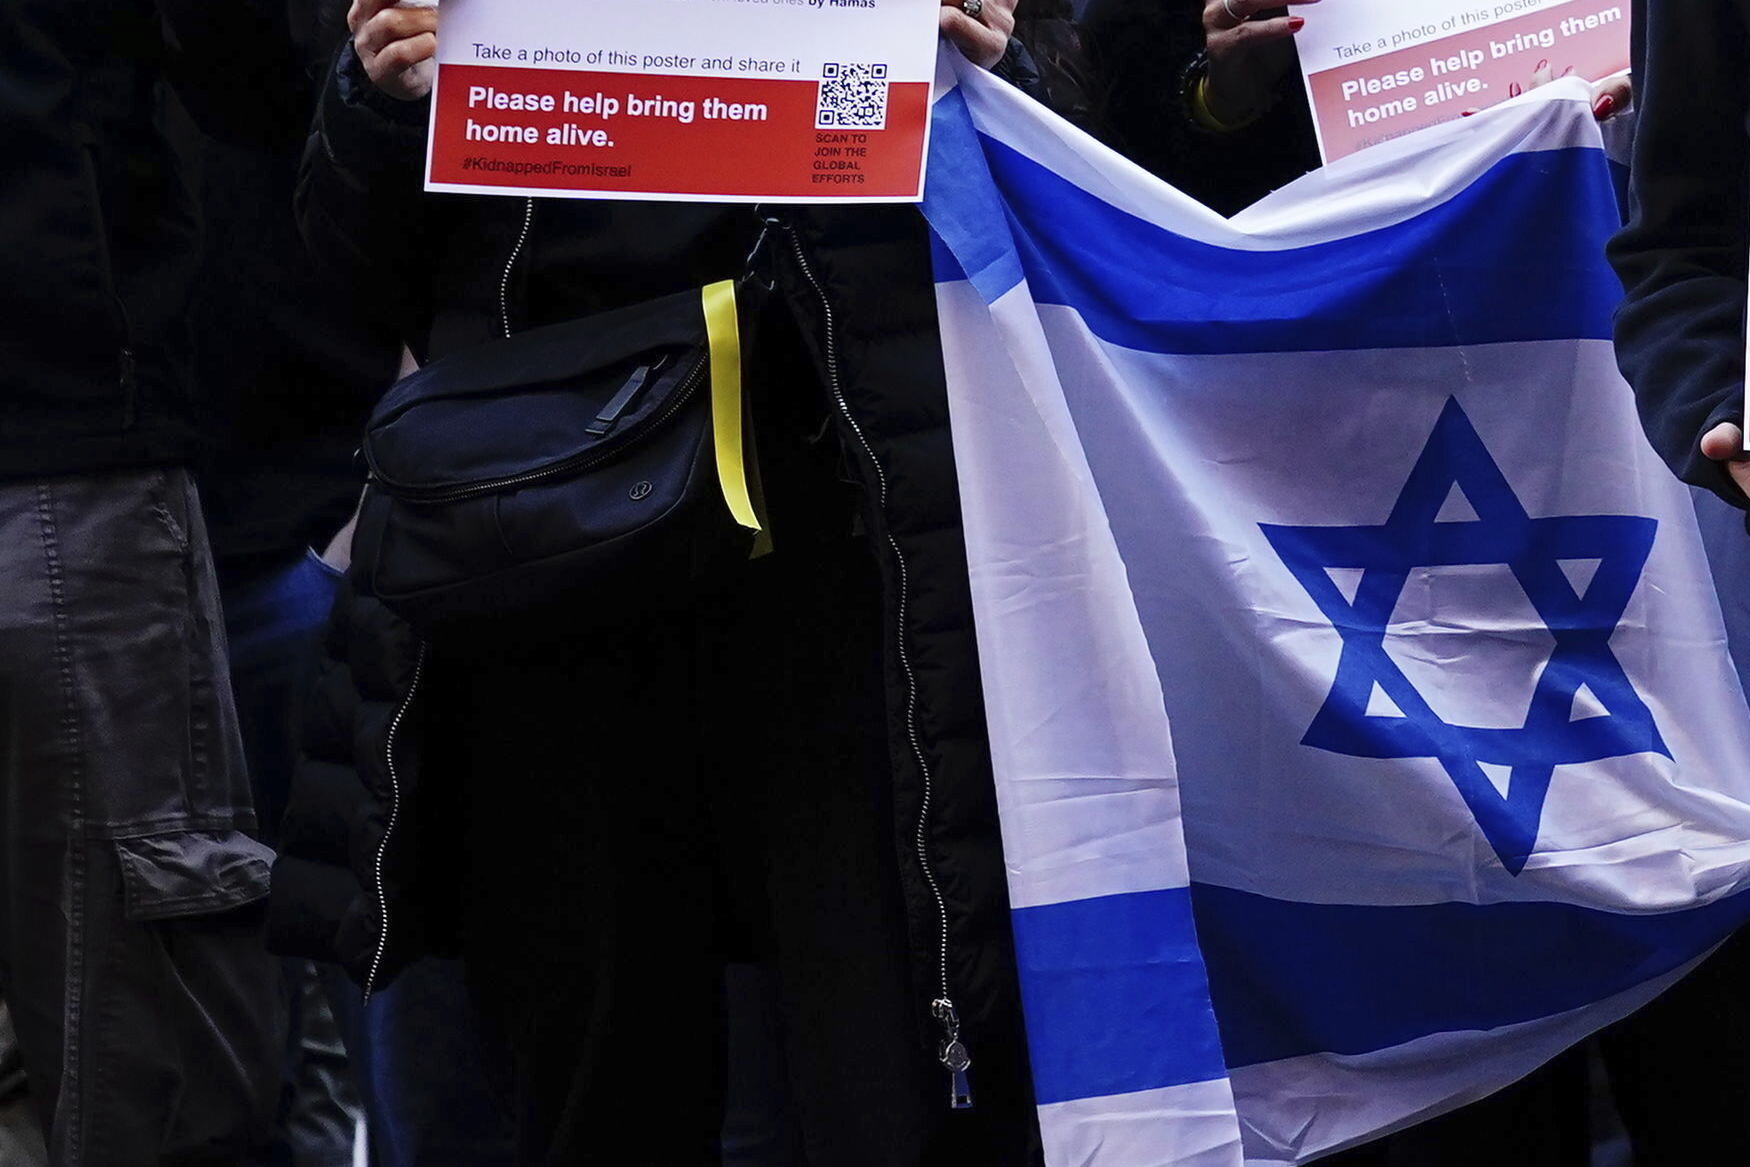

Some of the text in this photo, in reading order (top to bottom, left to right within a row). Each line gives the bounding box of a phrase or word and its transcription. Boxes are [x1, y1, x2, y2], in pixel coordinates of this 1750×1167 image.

[468, 85, 768, 124] Please help bring them
[465, 118, 614, 147] home alive.
